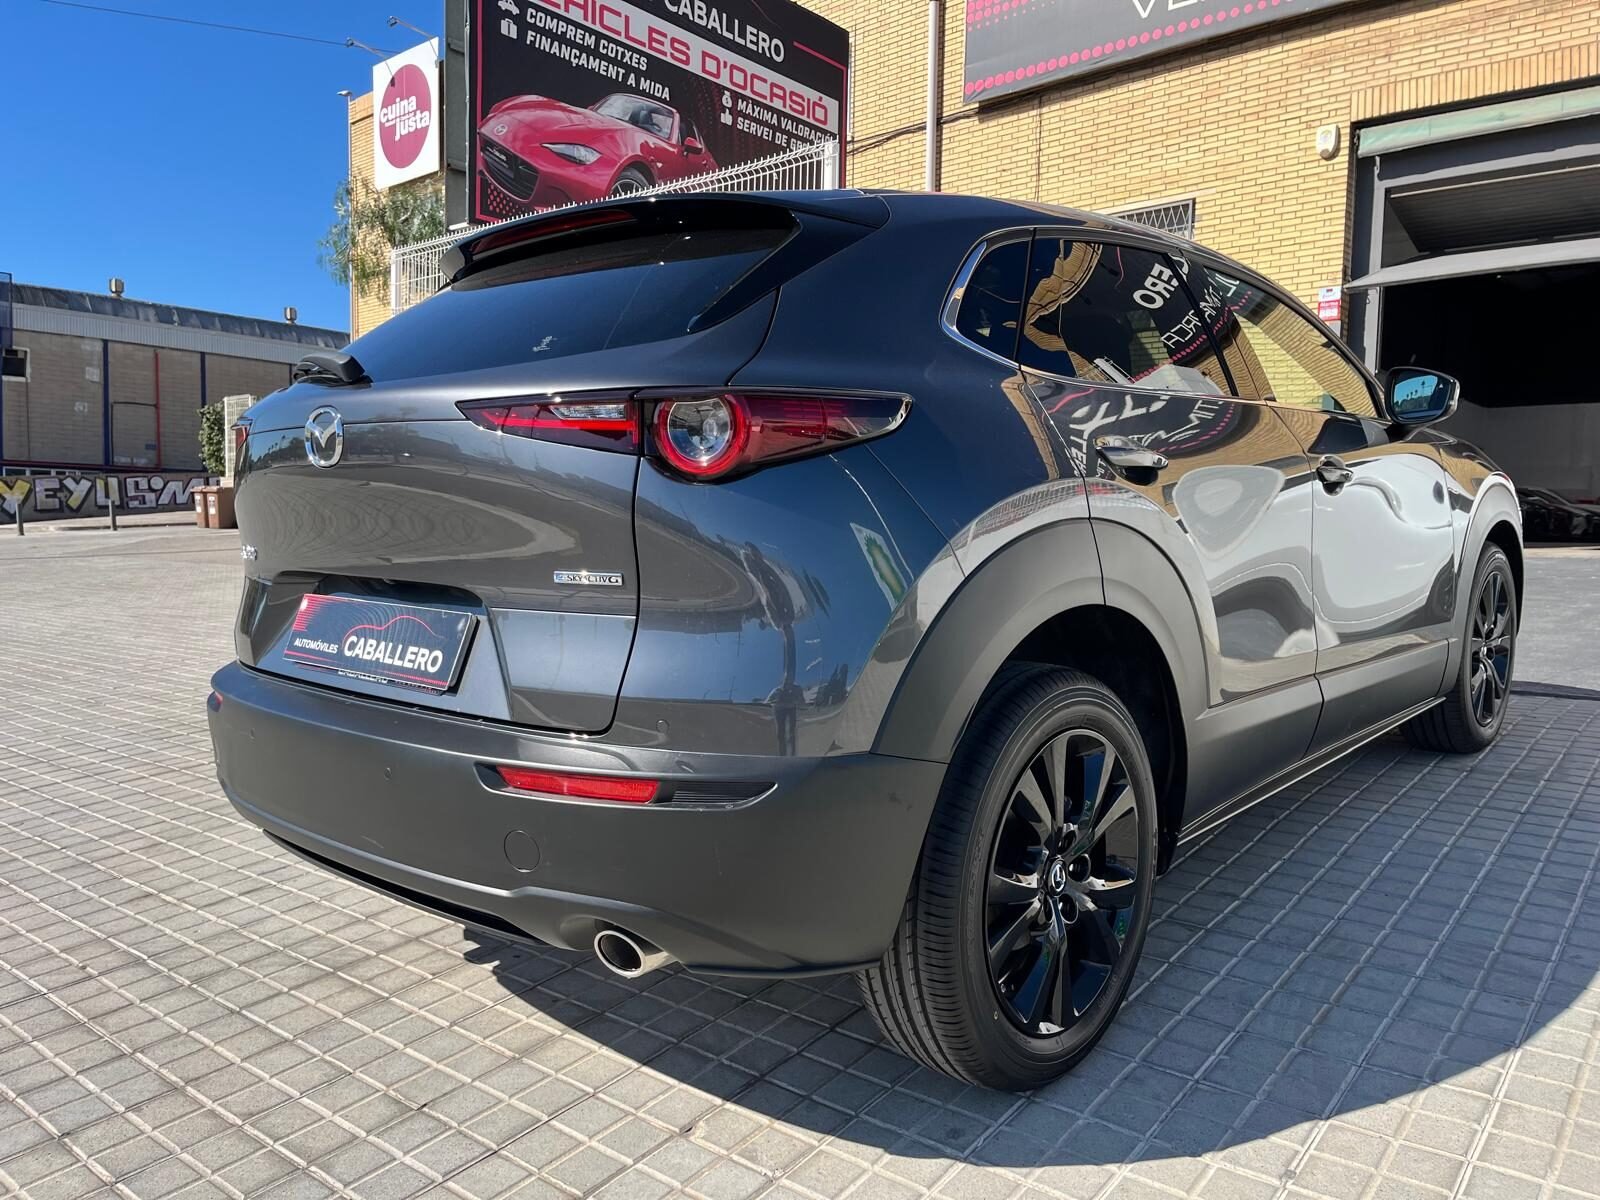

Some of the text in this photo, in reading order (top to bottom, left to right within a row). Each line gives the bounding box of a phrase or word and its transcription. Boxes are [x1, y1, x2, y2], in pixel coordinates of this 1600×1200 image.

[526, 7, 648, 71] COMPREM COTXES
[664, 0, 785, 63] CABALLERO
[526, 30, 670, 101] FINANÇAMENT A MIDA
[540, 0, 828, 126] HICLES D'OCASIÓ
[380, 95, 417, 124] cuina
[394, 109, 430, 142] justa
[737, 116, 788, 147] SERVEI DE
[293, 635, 443, 673] AUTOMÓVILES CABALLERO
